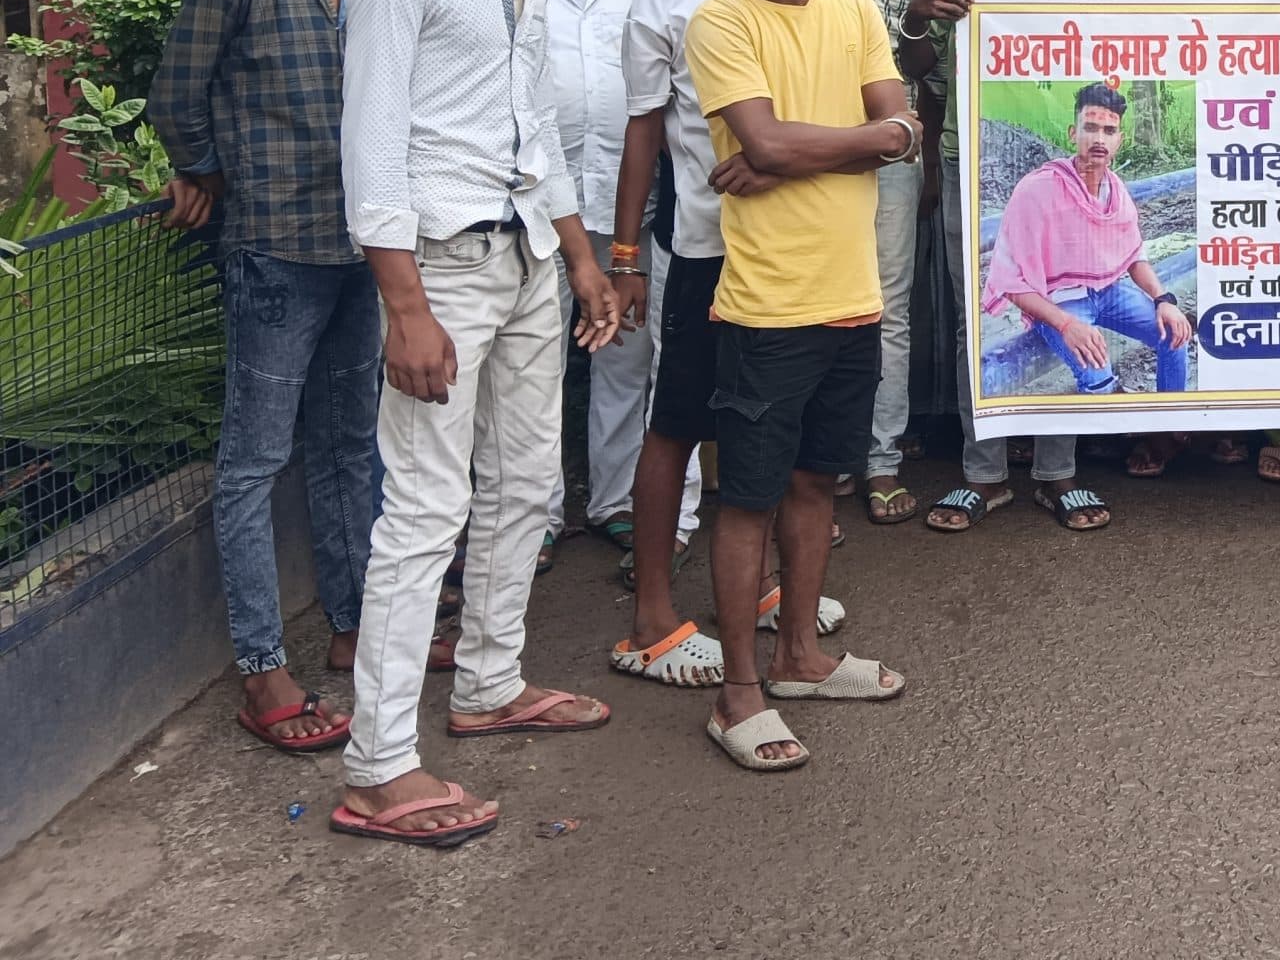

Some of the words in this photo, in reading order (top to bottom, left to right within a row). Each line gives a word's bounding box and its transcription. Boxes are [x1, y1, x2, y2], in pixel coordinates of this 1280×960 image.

[986, 20, 1082, 77] अश्वनी
[1090, 35, 1169, 90] कुमार
[1178, 19, 1208, 76] के
[1202, 91, 1276, 131] एवं
[1210, 199, 1267, 228] हत्या
[1220, 275, 1255, 298] एवं
[937, 489, 980, 509] NIKE
[1060, 490, 1105, 510] NIKE
